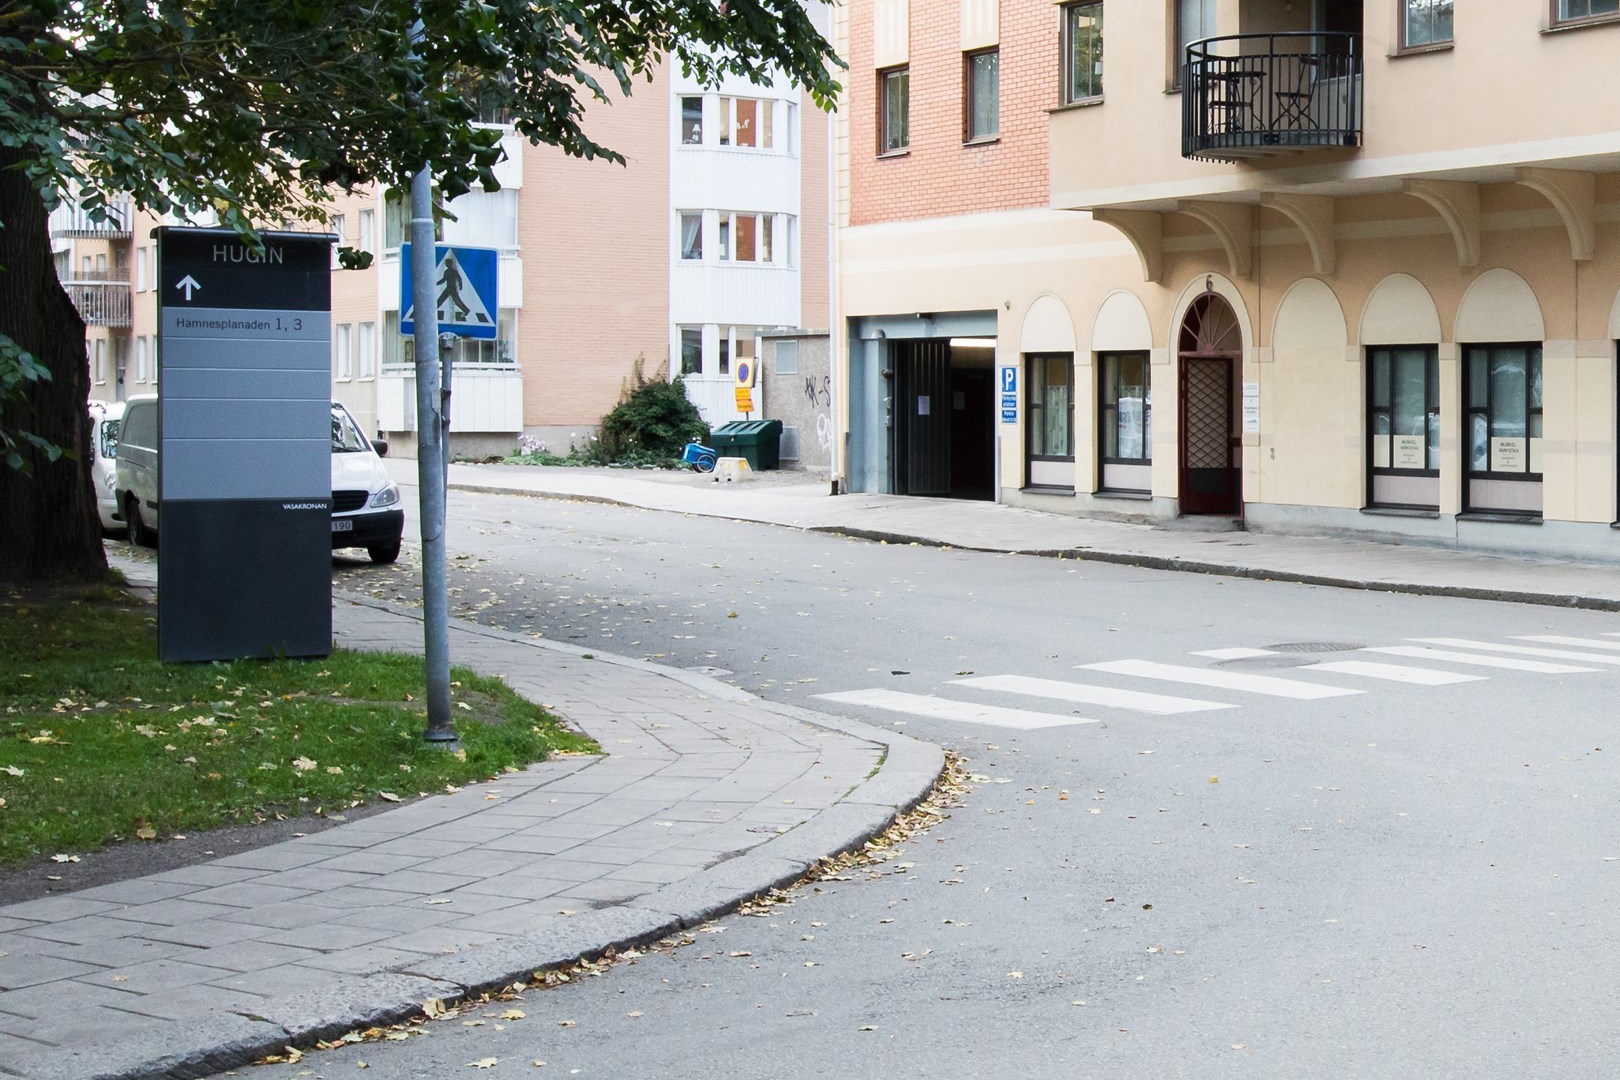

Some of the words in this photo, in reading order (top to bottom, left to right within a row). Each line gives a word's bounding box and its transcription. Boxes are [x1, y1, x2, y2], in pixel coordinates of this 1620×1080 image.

[1205, 274, 1214, 292] 6
[176, 317, 270, 331] Hamnesplanaden
[276, 317, 288, 332] 1,
[293, 318, 303, 331] 3
[1005, 368, 1014, 391] P
[333, 521, 352, 531] 190
